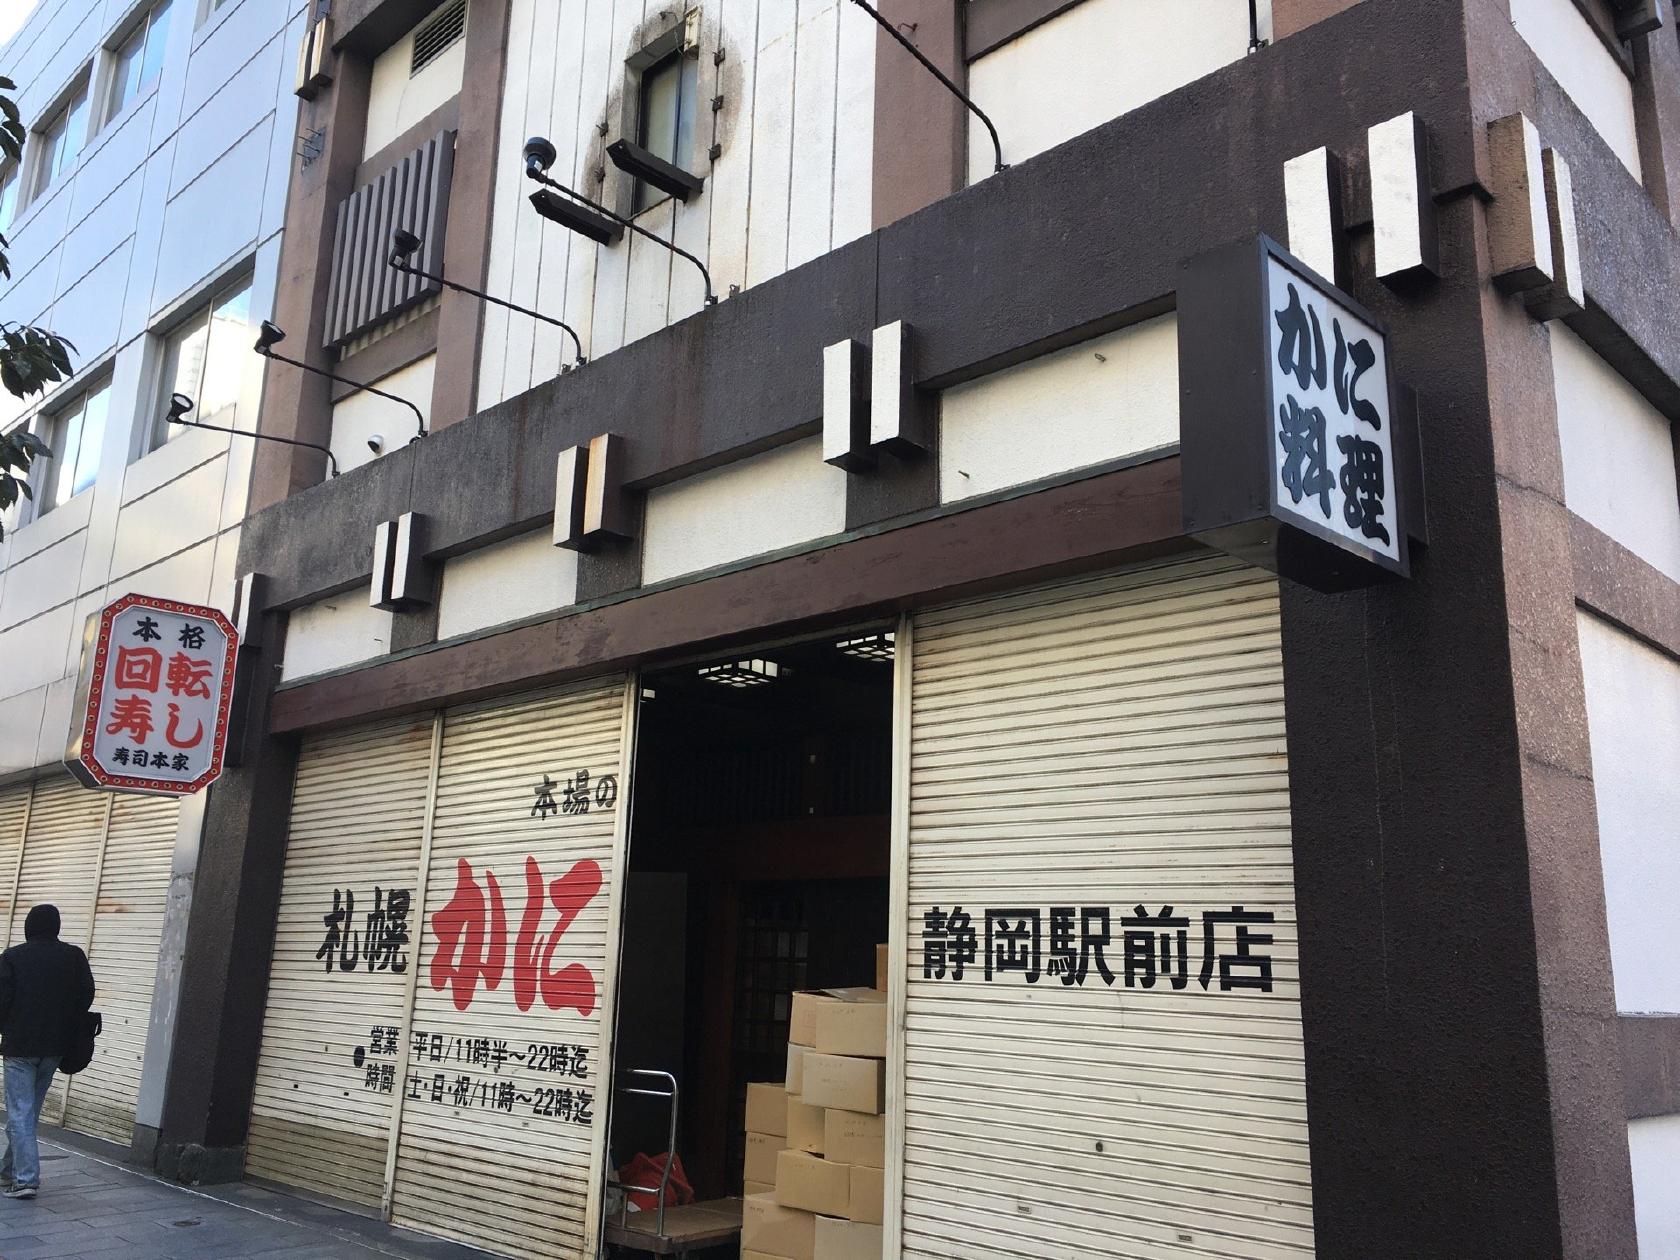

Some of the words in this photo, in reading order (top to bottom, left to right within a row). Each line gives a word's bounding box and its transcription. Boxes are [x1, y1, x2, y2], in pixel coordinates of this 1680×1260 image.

[1275, 282, 1382, 431] かに
[1278, 394, 1391, 547] 料理
[132, 616, 207, 650] 本格
[114, 645, 214, 700] 回転
[105, 694, 204, 749] 寿し
[112, 746, 190, 772] 寿司本家
[530, 769, 618, 821] 本場の
[315, 885, 411, 975] 札幌
[430, 855, 603, 1017] かに
[922, 903, 1275, 993] 静岡駅前店
[369, 1026, 400, 1056] 営業
[364, 1062, 396, 1094] 時間
